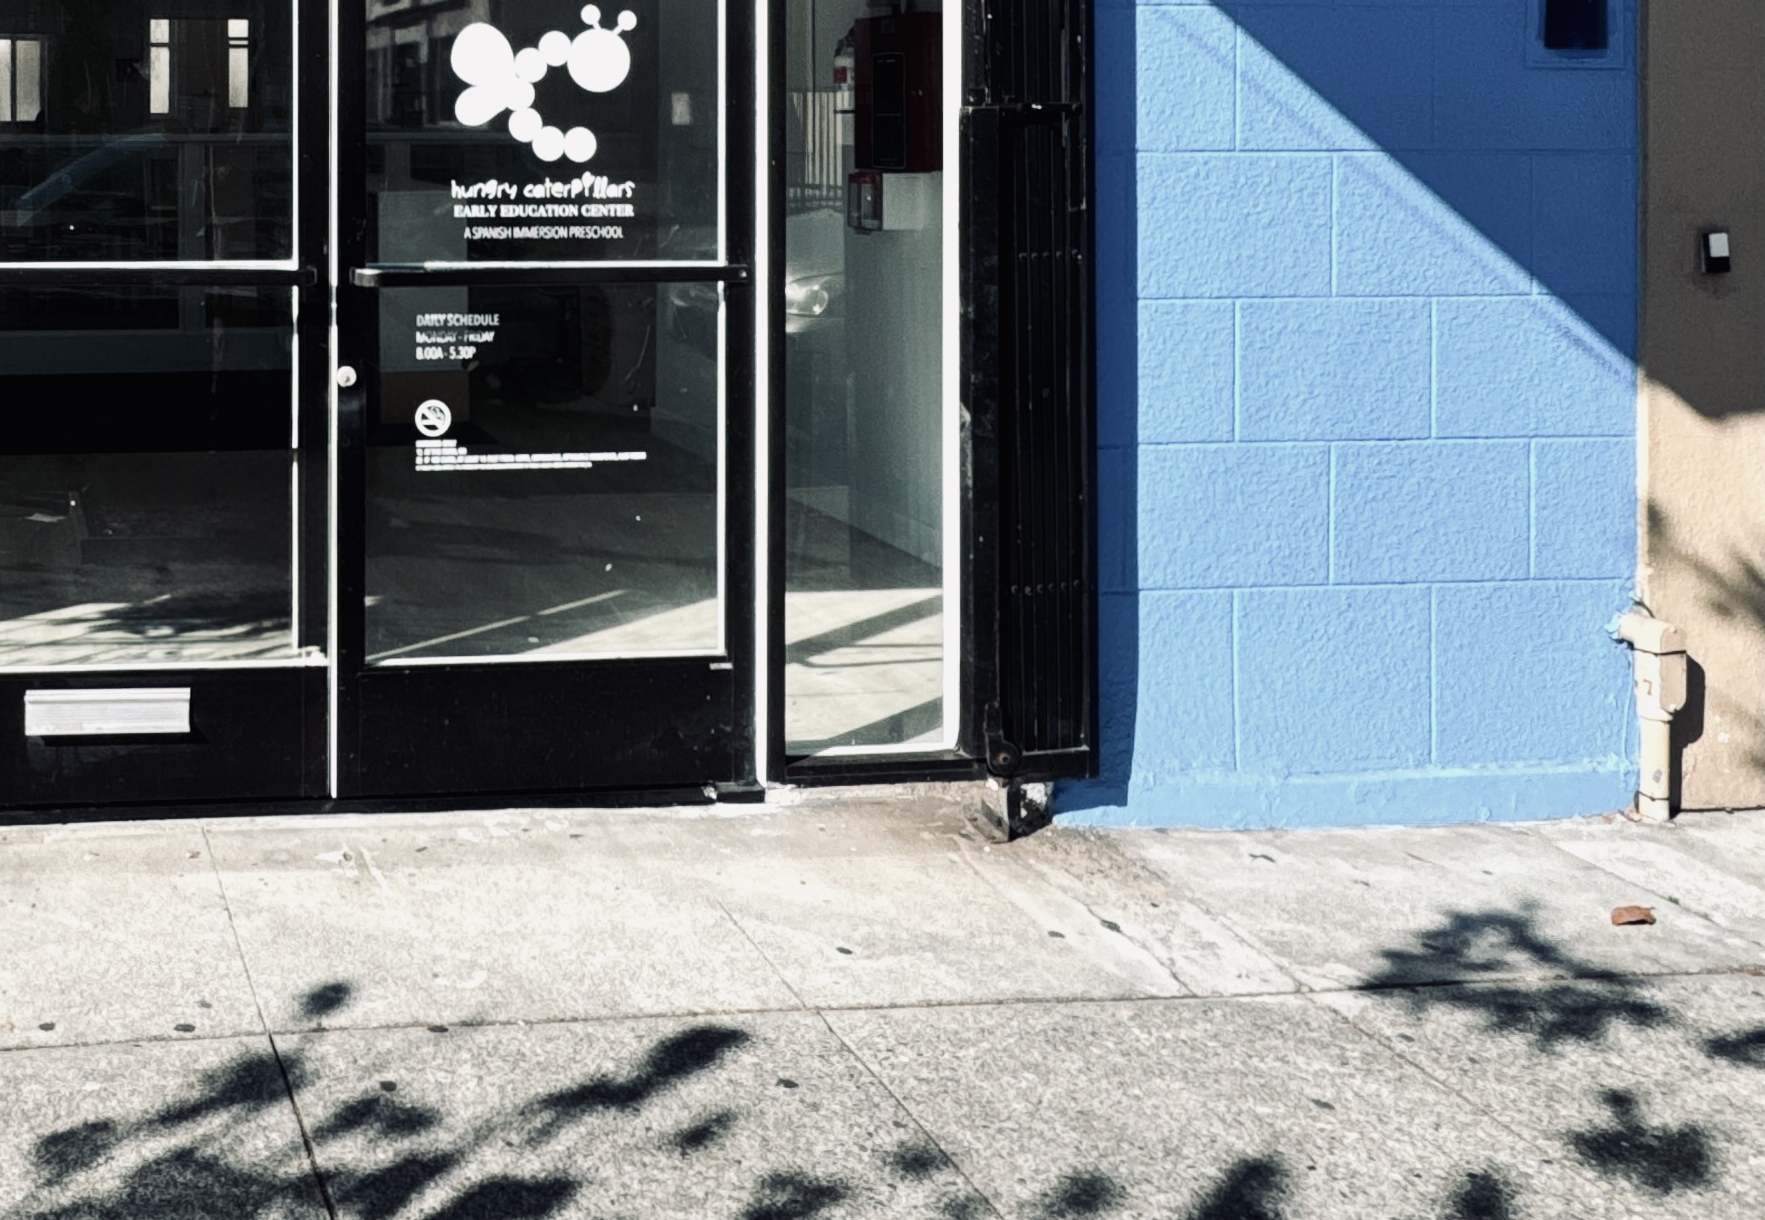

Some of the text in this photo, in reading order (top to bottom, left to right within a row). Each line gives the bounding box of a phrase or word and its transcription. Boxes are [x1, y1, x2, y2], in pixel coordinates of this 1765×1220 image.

[450, 171, 636, 200] hungry caterpillars
[453, 204, 635, 218] EARLY EDUCATION CENTER
[472, 226, 512, 240] SPANISH
[513, 226, 568, 240] IMMERSION
[569, 226, 624, 240] PRESCHOOL
[446, 313, 500, 327] SCHEDULE
